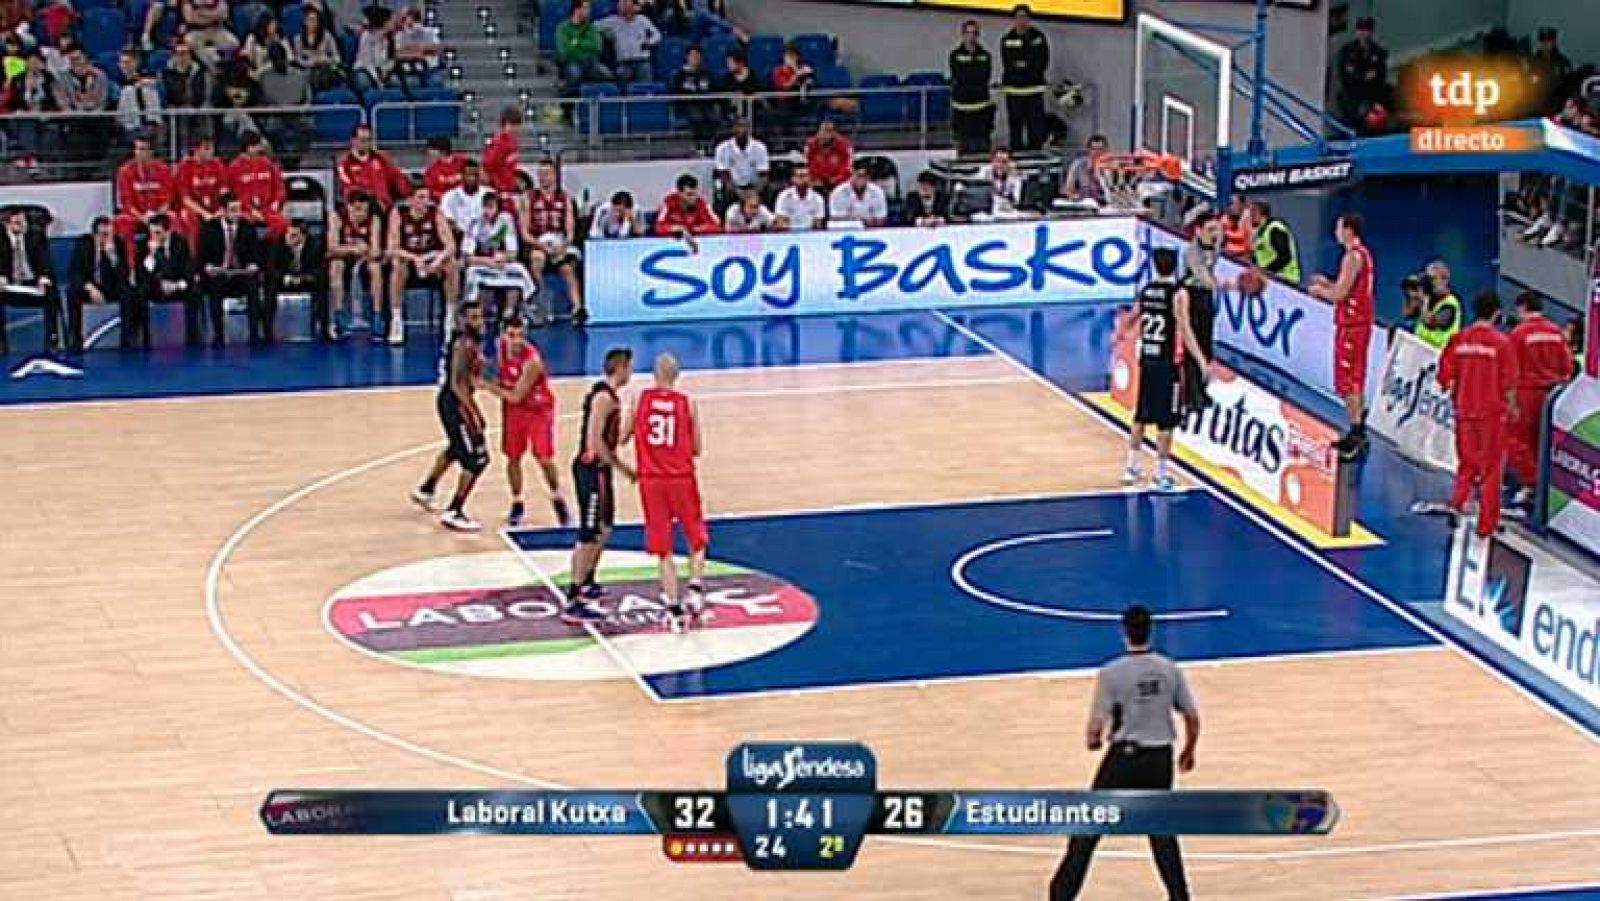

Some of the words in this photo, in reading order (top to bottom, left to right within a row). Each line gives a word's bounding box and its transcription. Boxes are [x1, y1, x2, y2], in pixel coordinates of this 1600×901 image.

[1234, 170, 1286, 190] QUINI
[1288, 161, 1351, 184] BASKET
[639, 244, 801, 309] Soy
[1140, 313, 1166, 342] 22
[646, 413, 676, 448] 31
[1180, 393, 1285, 474] rutas
